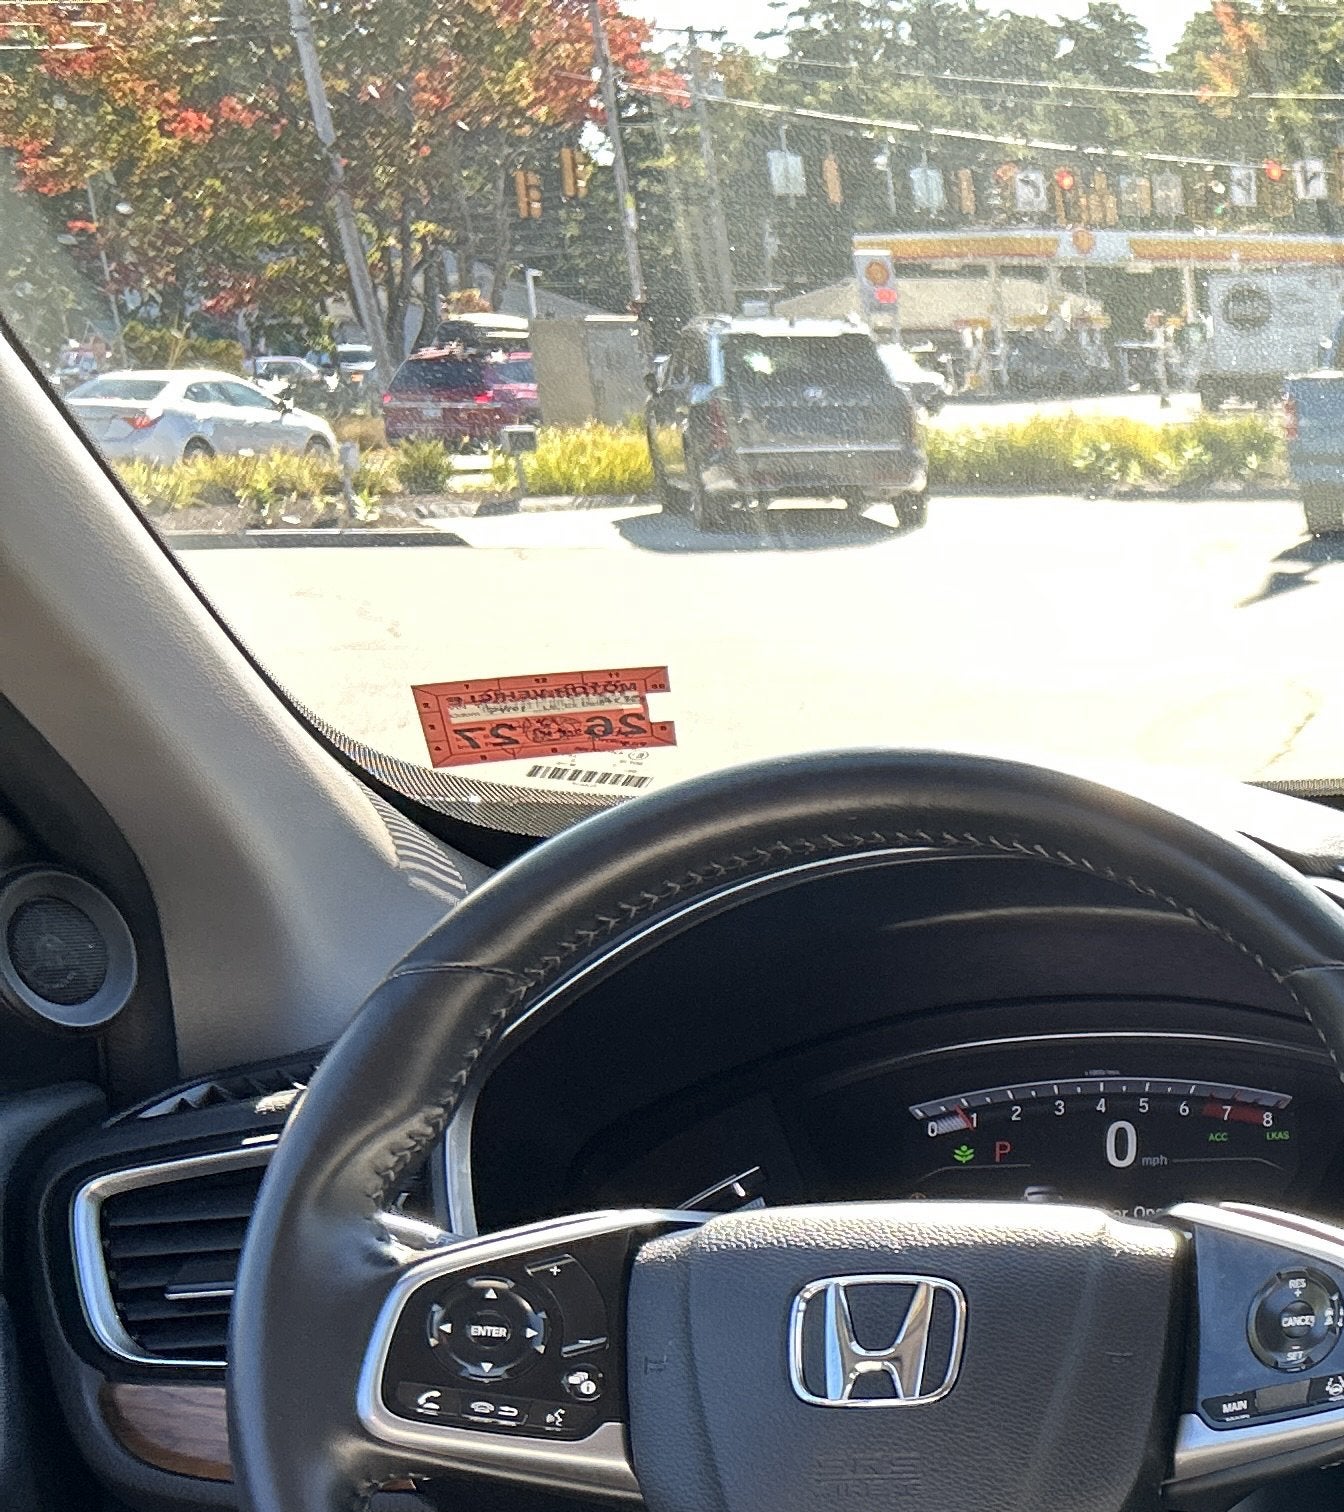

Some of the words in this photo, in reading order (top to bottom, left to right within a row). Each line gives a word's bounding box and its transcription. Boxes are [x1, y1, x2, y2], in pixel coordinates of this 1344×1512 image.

[1011, 1105, 1022, 1122] 2
[1054, 1099, 1065, 1116] 3
[1095, 1098, 1106, 1114] 4
[1138, 1097, 1149, 1114] 5
[1179, 1100, 1190, 1117] 6
[1221, 1104, 1232, 1121] 7
[1262, 1111, 1273, 1128] 8
[1105, 1120, 1138, 1168] 0
[1141, 1154, 1168, 1167] mph
[1208, 1131, 1229, 1142] ACC
[1265, 1130, 1290, 1141] LKAS
[994, 1140, 1012, 1162] P
[470, 1325, 507, 1338] ENTER
[1286, 1351, 1304, 1361] SET
[1222, 1400, 1248, 1413] MAIN
